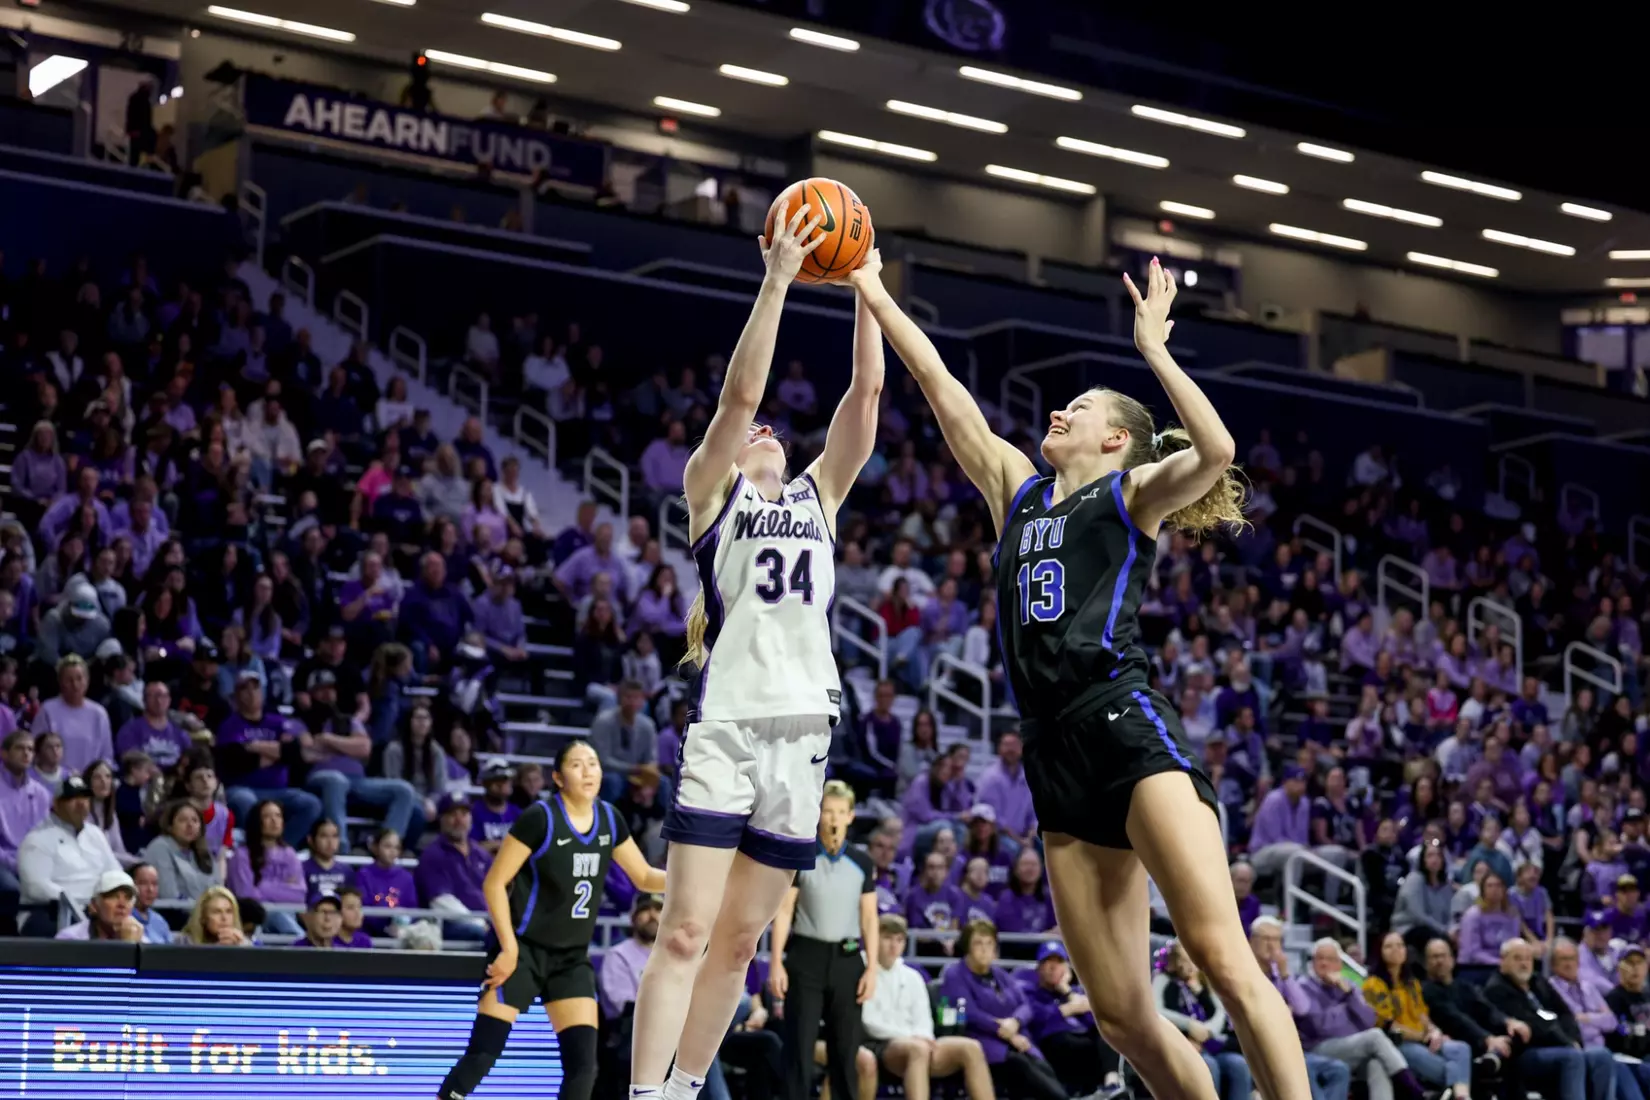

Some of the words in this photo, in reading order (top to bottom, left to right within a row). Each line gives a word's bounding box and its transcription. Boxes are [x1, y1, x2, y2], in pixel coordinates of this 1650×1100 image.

[849, 193, 862, 241] ELIT
[734, 508, 823, 542] Wildcats
[1019, 515, 1068, 556] BYU
[755, 547, 814, 605] 34
[1017, 558, 1065, 625] 13
[572, 852, 600, 877] BYU
[571, 880, 593, 918] 2
[53, 1026, 170, 1072] Built
[190, 1028, 261, 1074] for
